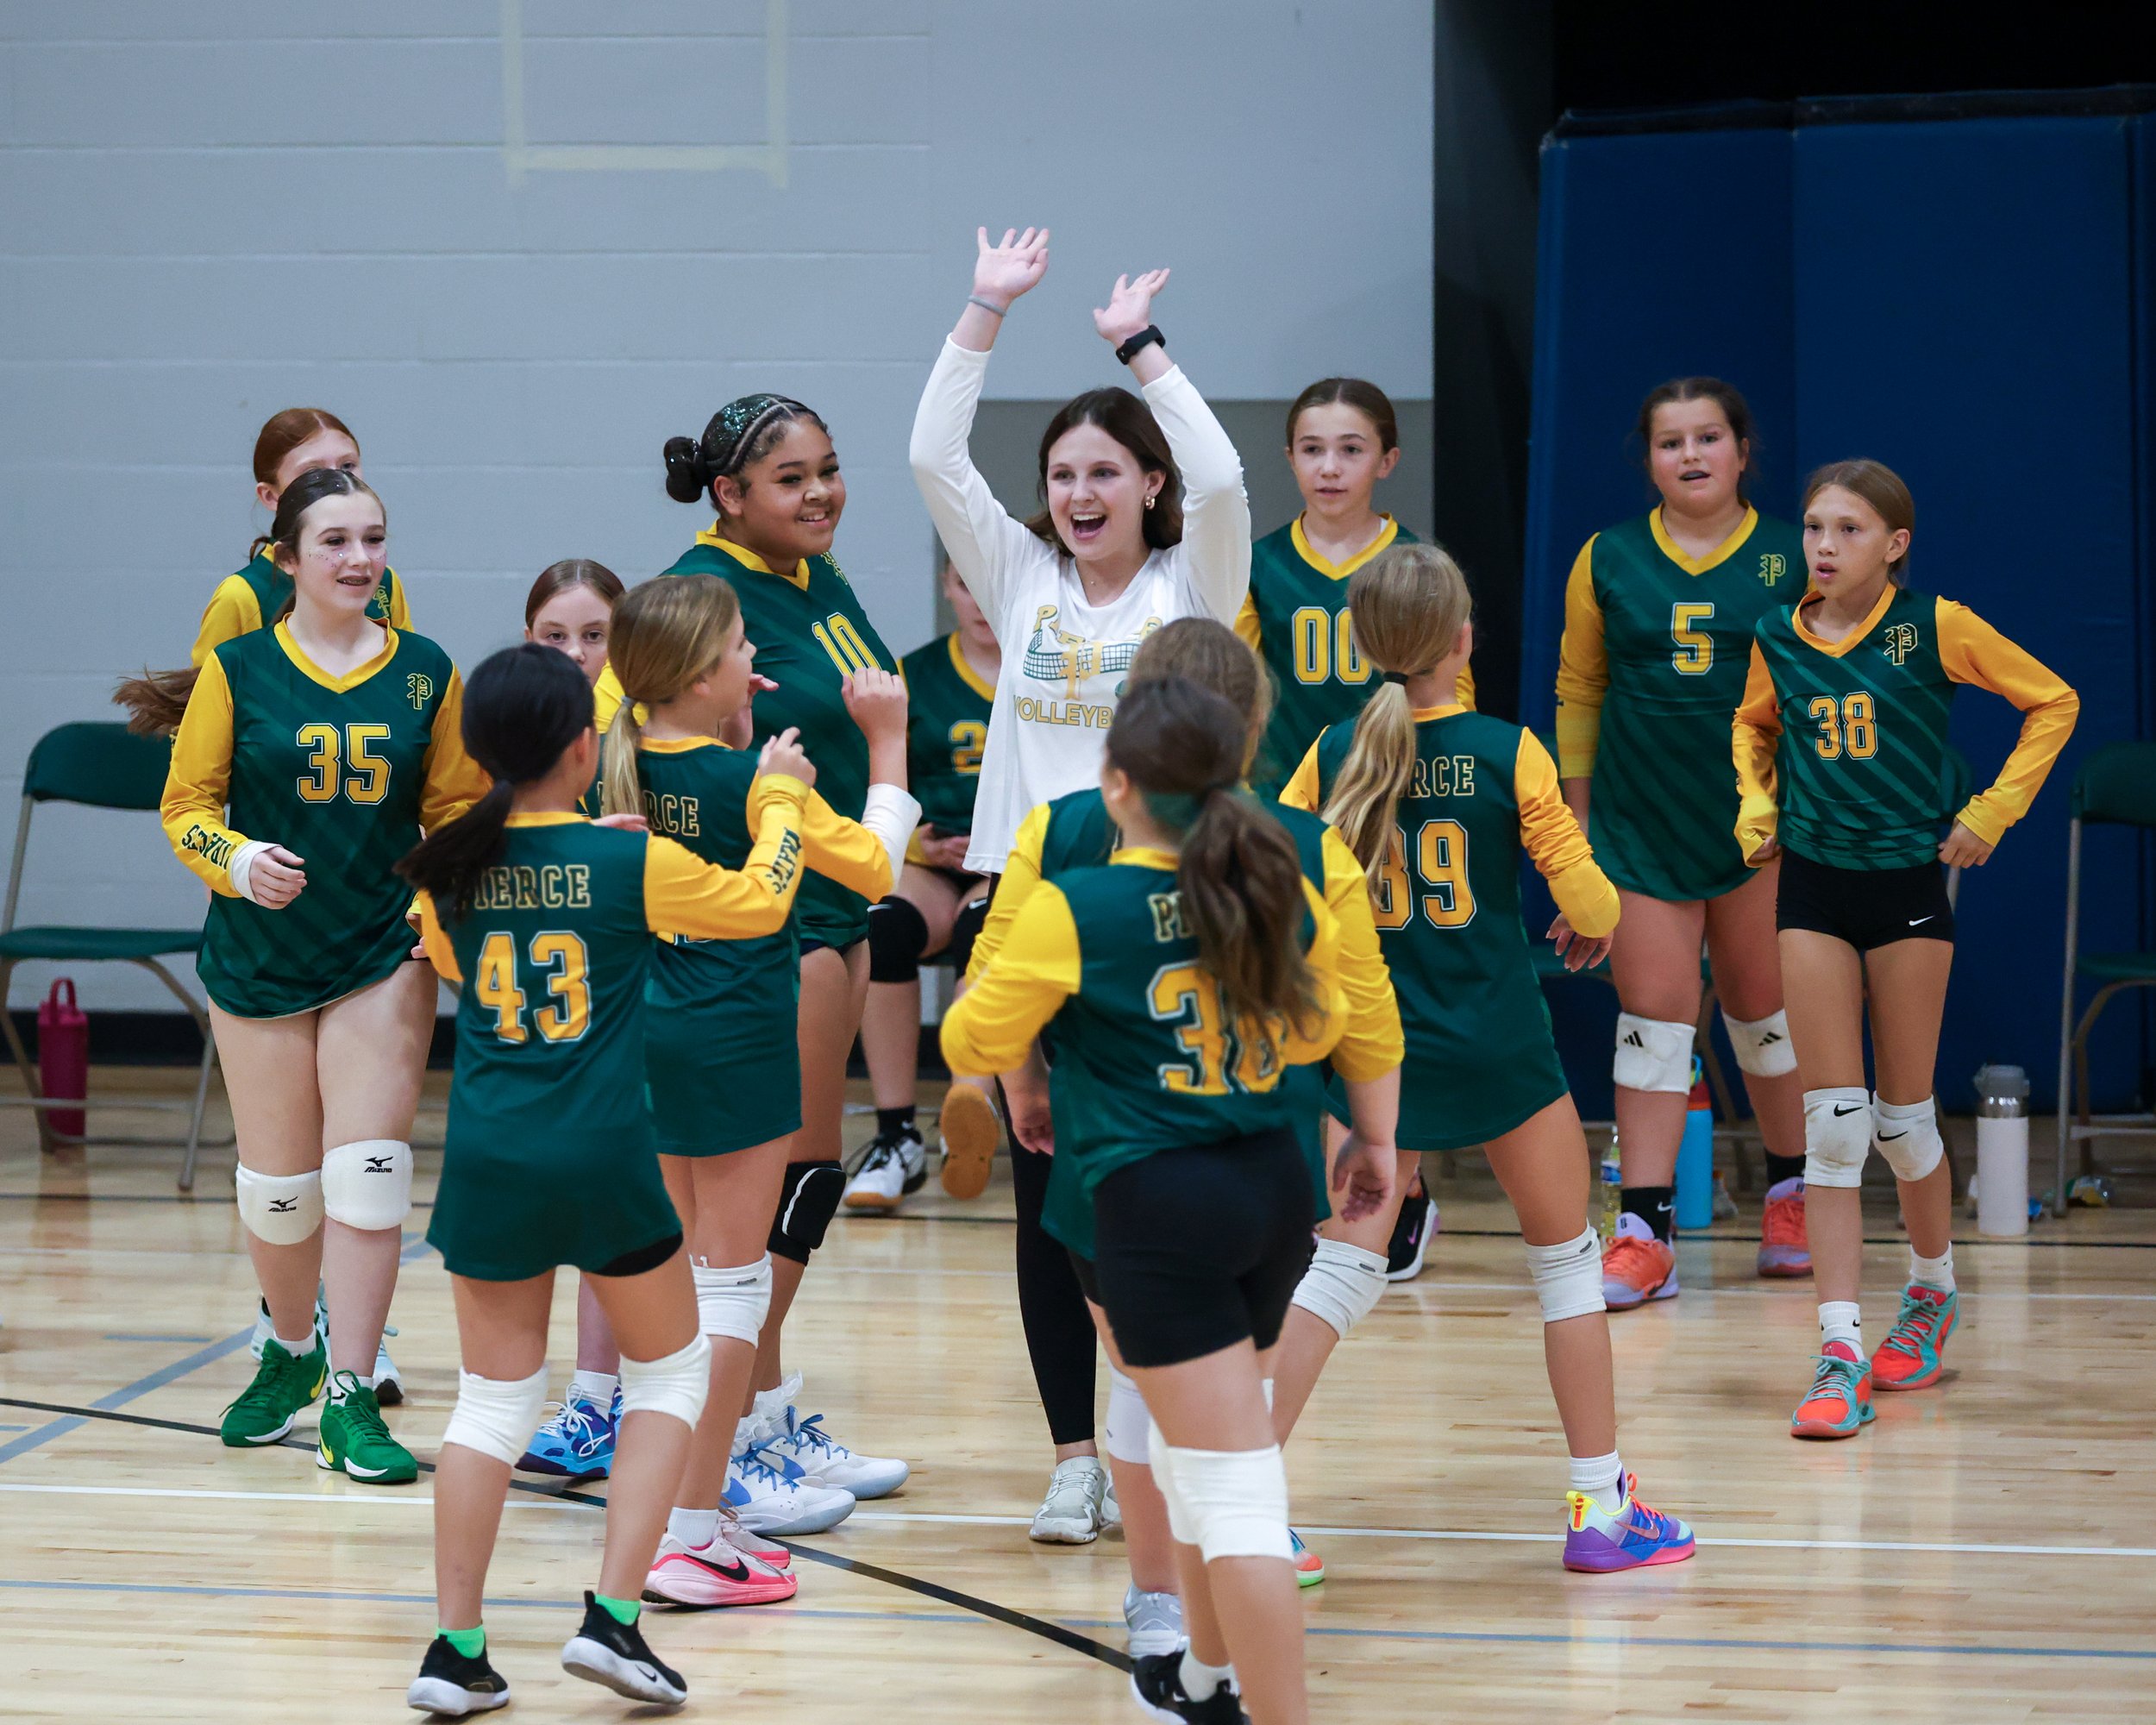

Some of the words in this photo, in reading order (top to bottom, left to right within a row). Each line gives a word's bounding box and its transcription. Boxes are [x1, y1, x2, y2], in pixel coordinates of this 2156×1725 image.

[812, 612, 883, 684] 10
[1292, 605, 1373, 686] 00
[1670, 602, 1715, 675] 5
[1883, 623, 1918, 666] P
[406, 673, 433, 710] P
[1808, 691, 1879, 761] 38
[297, 723, 392, 806] 35
[475, 864, 592, 909] IERCE
[475, 930, 592, 1044] 43
